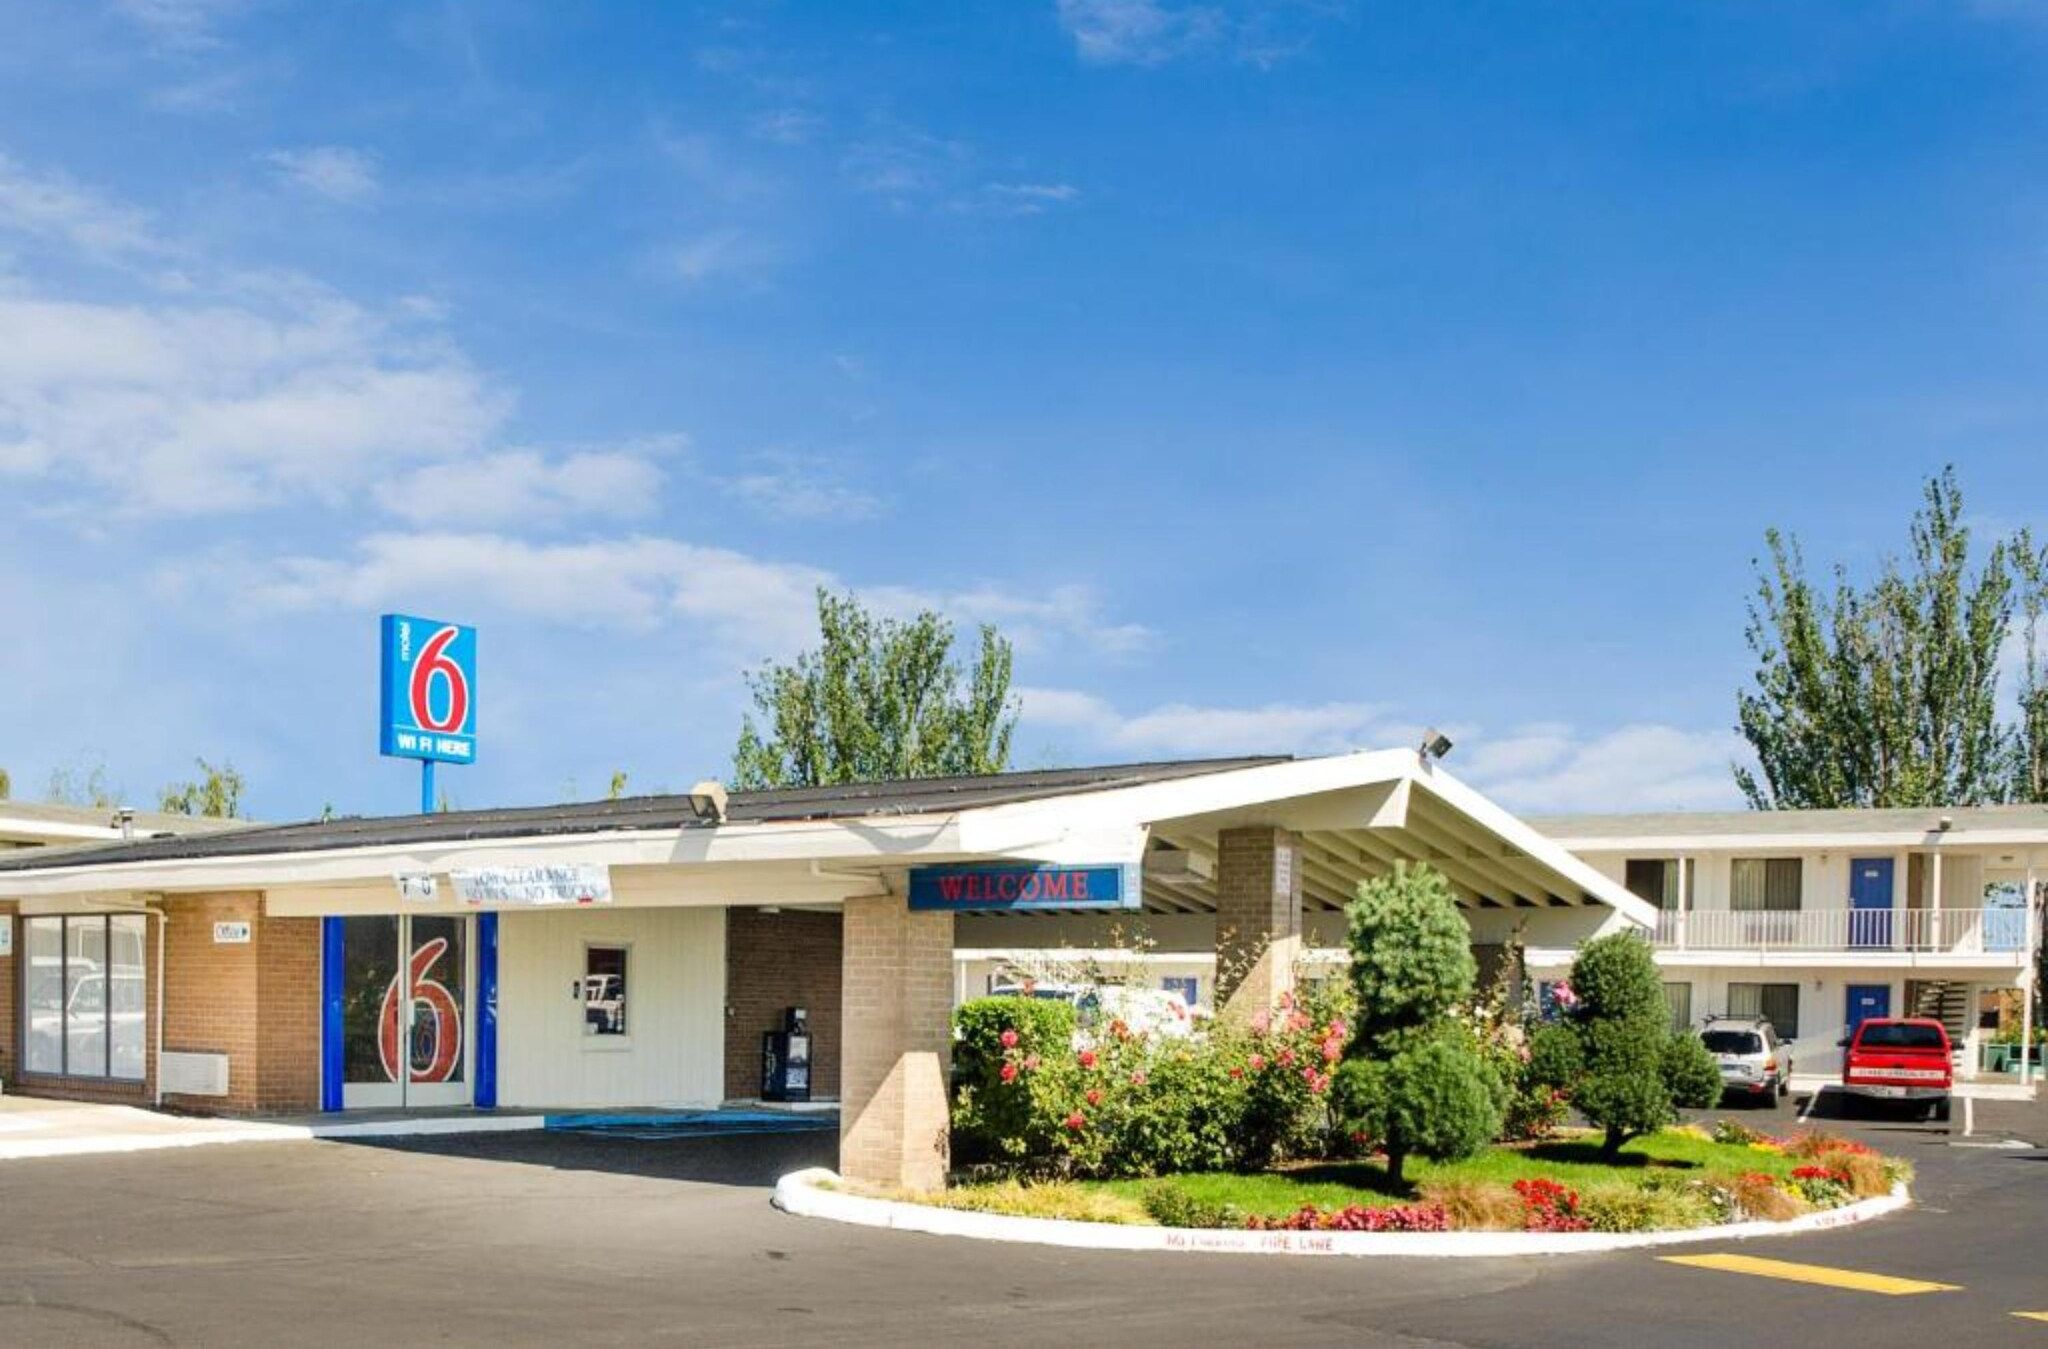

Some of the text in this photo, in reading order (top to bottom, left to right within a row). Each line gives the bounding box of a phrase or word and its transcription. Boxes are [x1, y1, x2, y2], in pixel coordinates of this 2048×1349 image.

[409, 625, 469, 734] 6
[397, 733, 471, 757] WI FI HERE
[938, 871, 1090, 900] WELCOME
[378, 936, 461, 1083] 6
